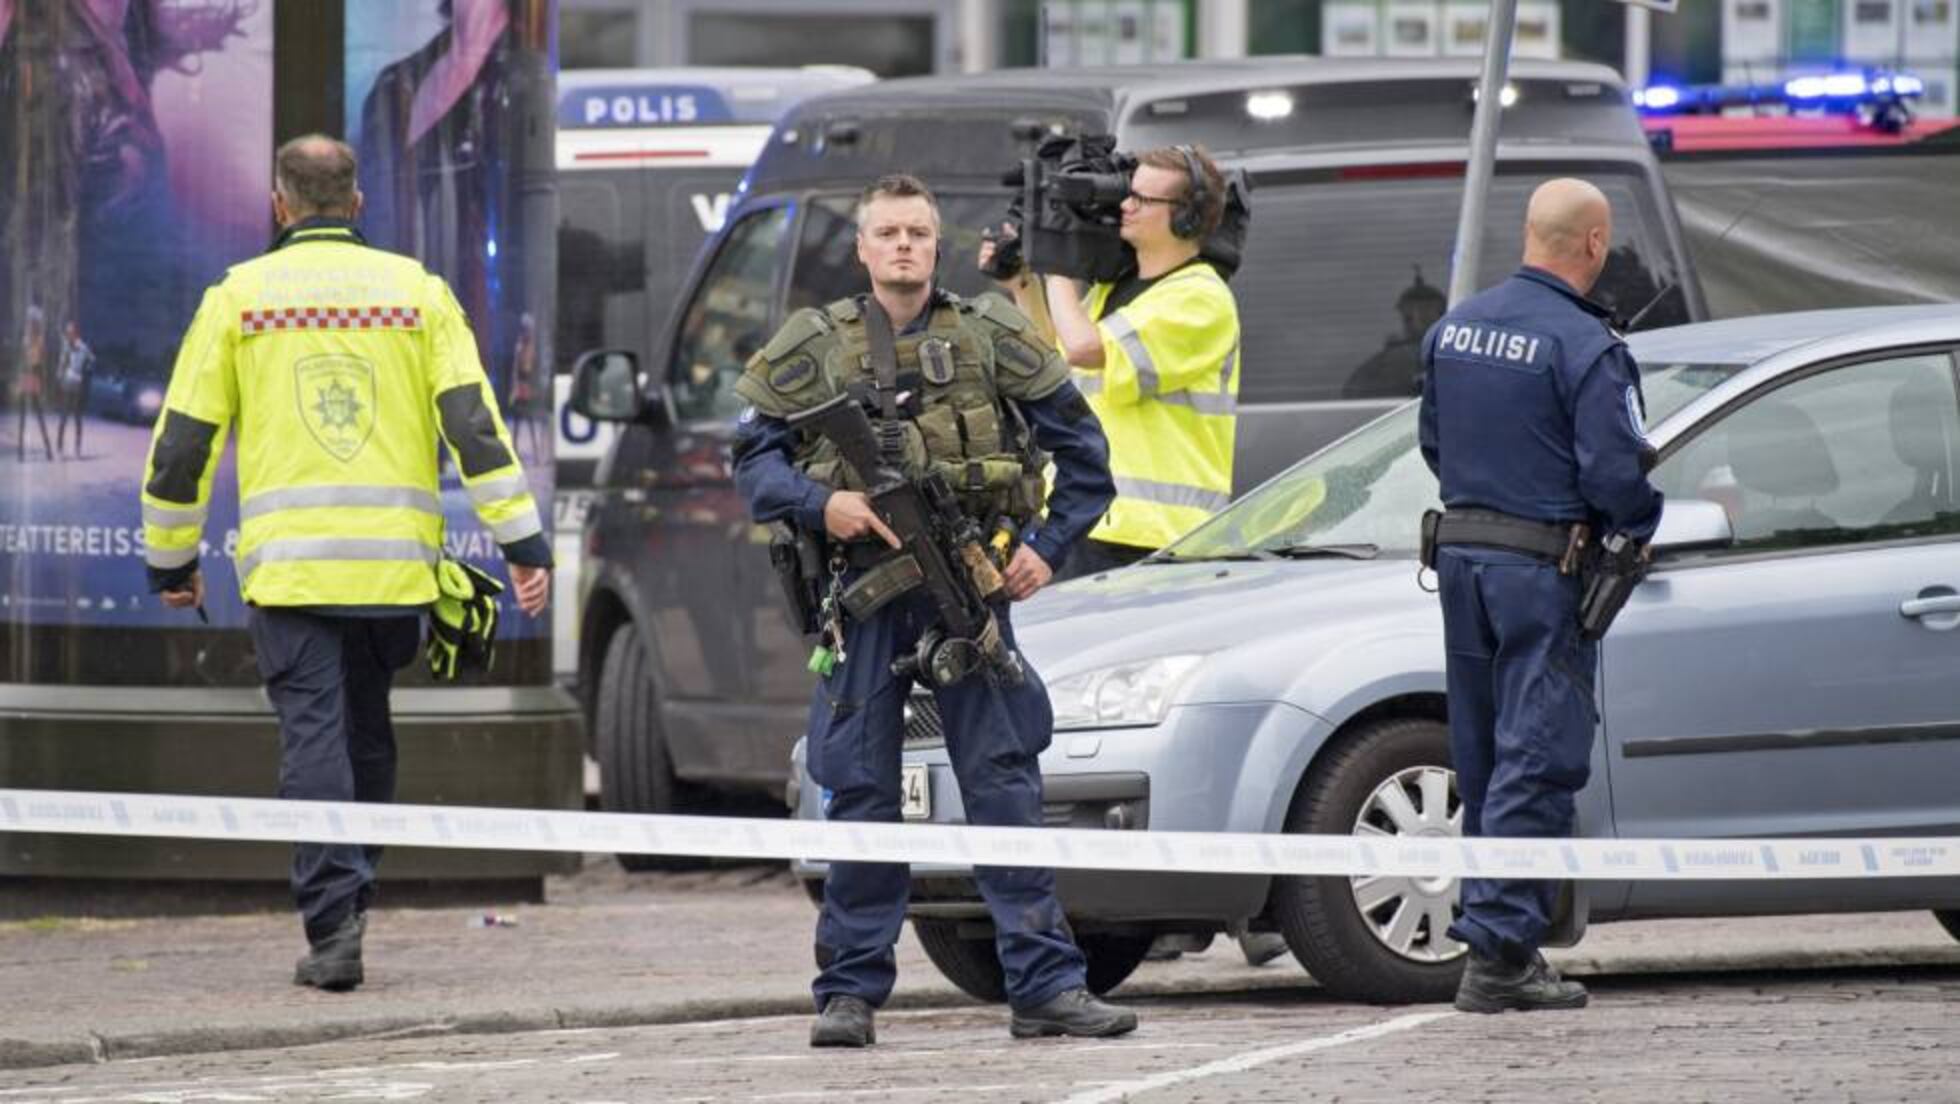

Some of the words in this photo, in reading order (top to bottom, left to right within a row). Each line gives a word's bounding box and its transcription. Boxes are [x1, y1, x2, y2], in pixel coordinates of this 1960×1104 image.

[585, 95, 697, 124] POLIS
[1440, 324, 1539, 364] POLIISI
[0, 524, 145, 556] TEATTEREISS
